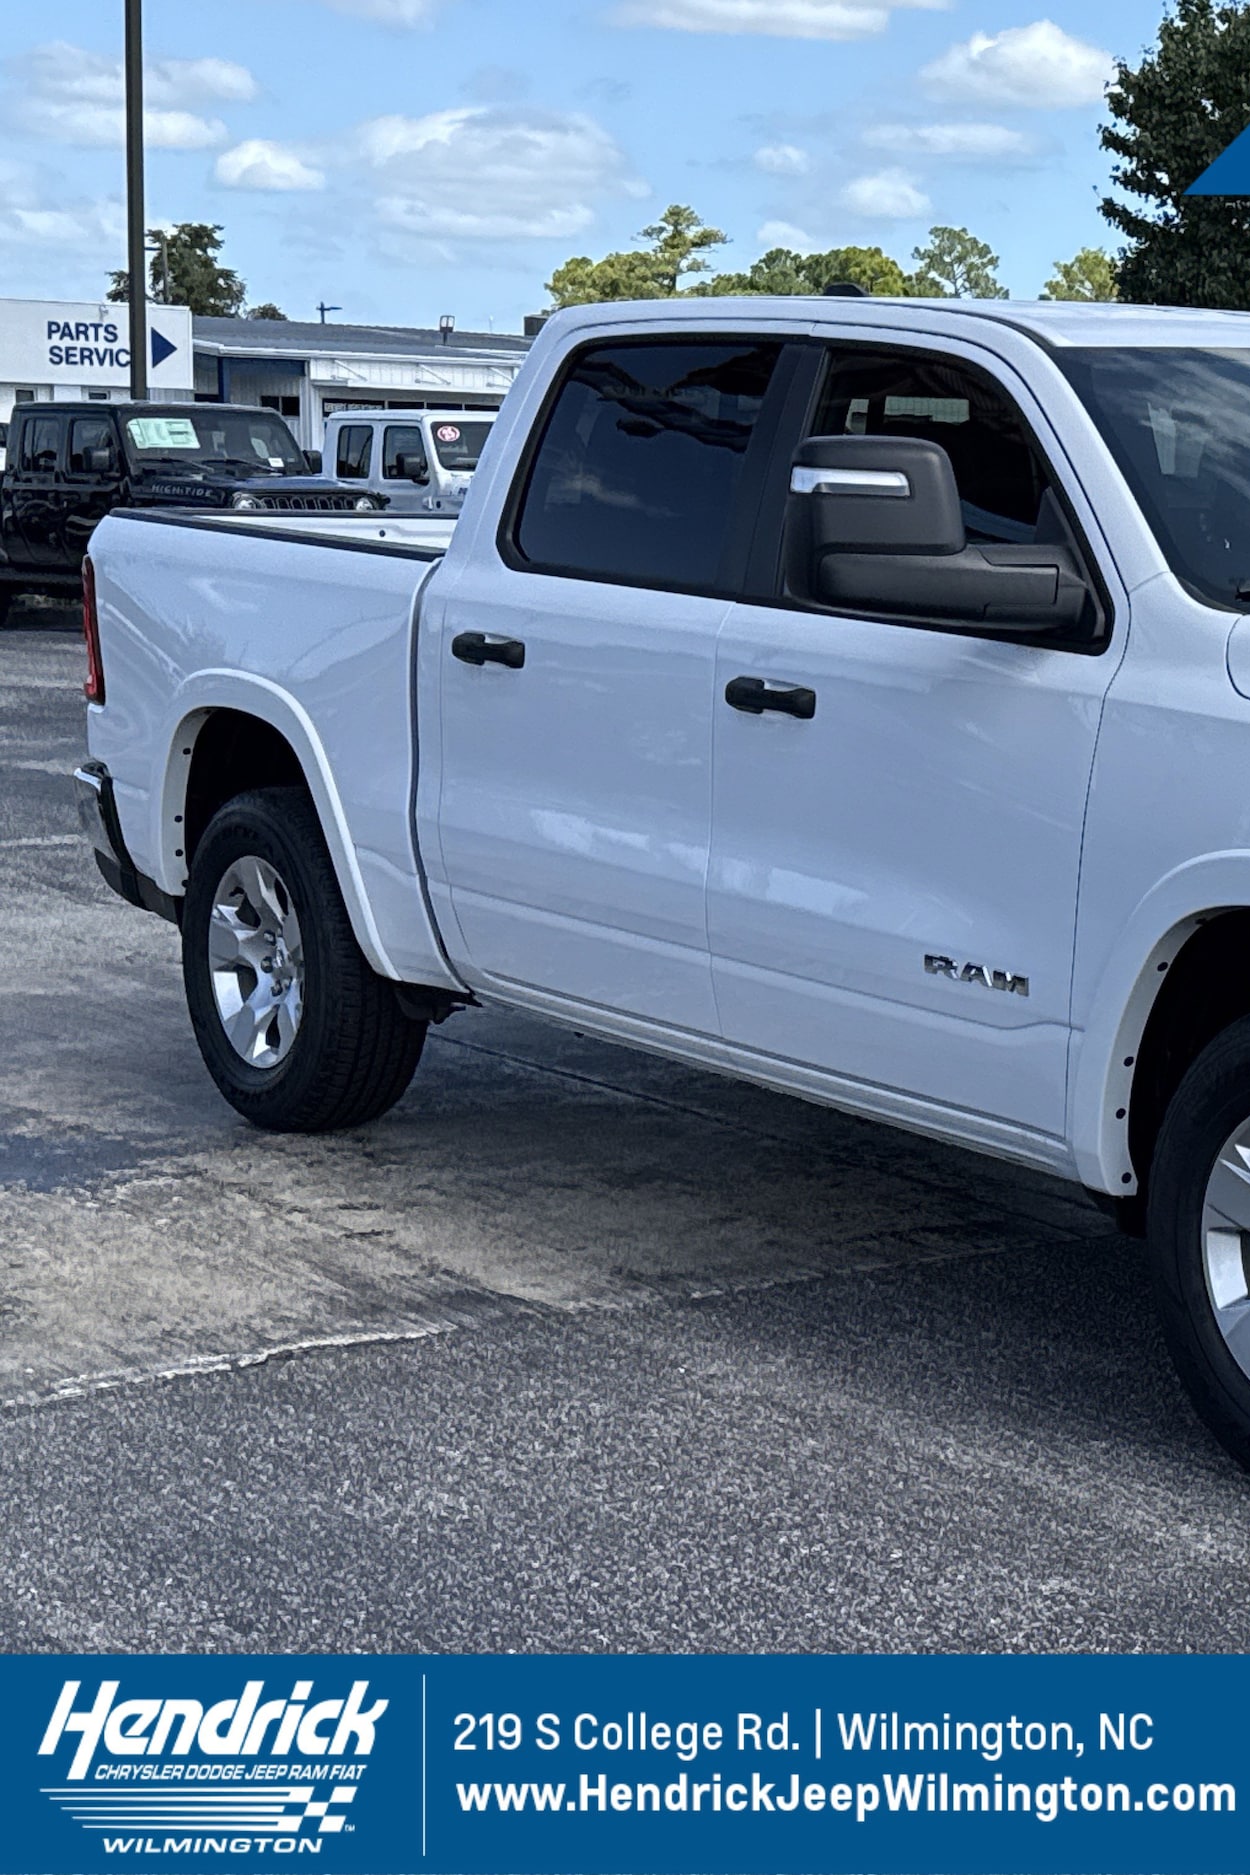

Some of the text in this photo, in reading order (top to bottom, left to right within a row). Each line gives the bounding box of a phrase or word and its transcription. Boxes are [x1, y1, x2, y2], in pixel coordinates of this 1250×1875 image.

[47, 320, 118, 343] PARTS
[49, 345, 131, 368] SERVIC
[923, 953, 1029, 997] RAM
